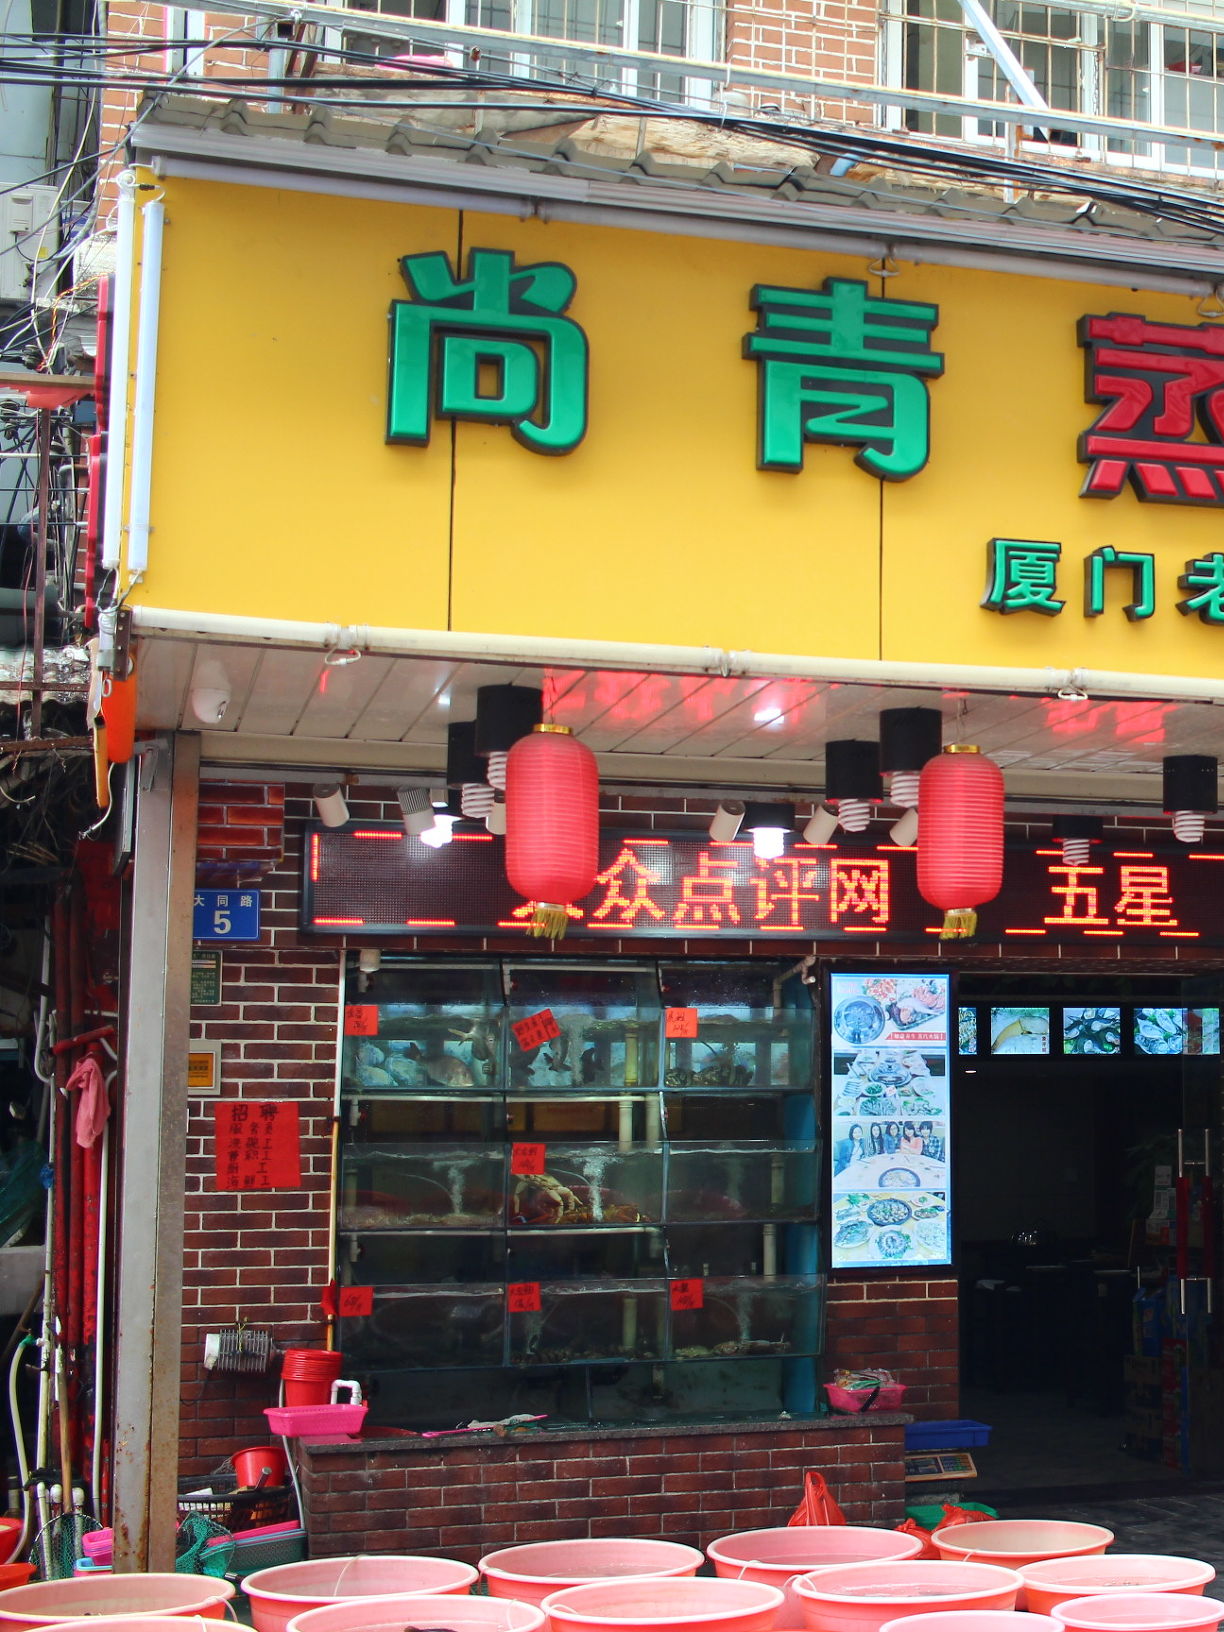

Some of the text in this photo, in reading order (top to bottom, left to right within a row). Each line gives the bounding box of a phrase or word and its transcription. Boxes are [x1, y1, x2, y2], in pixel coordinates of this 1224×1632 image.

[511, 848, 890, 925] 众点评网
[1044, 866, 1178, 926] 五星
[194, 894, 253, 908] 大同路
[213, 910, 232, 935] 5
[231, 1103, 280, 1122] 招聘
